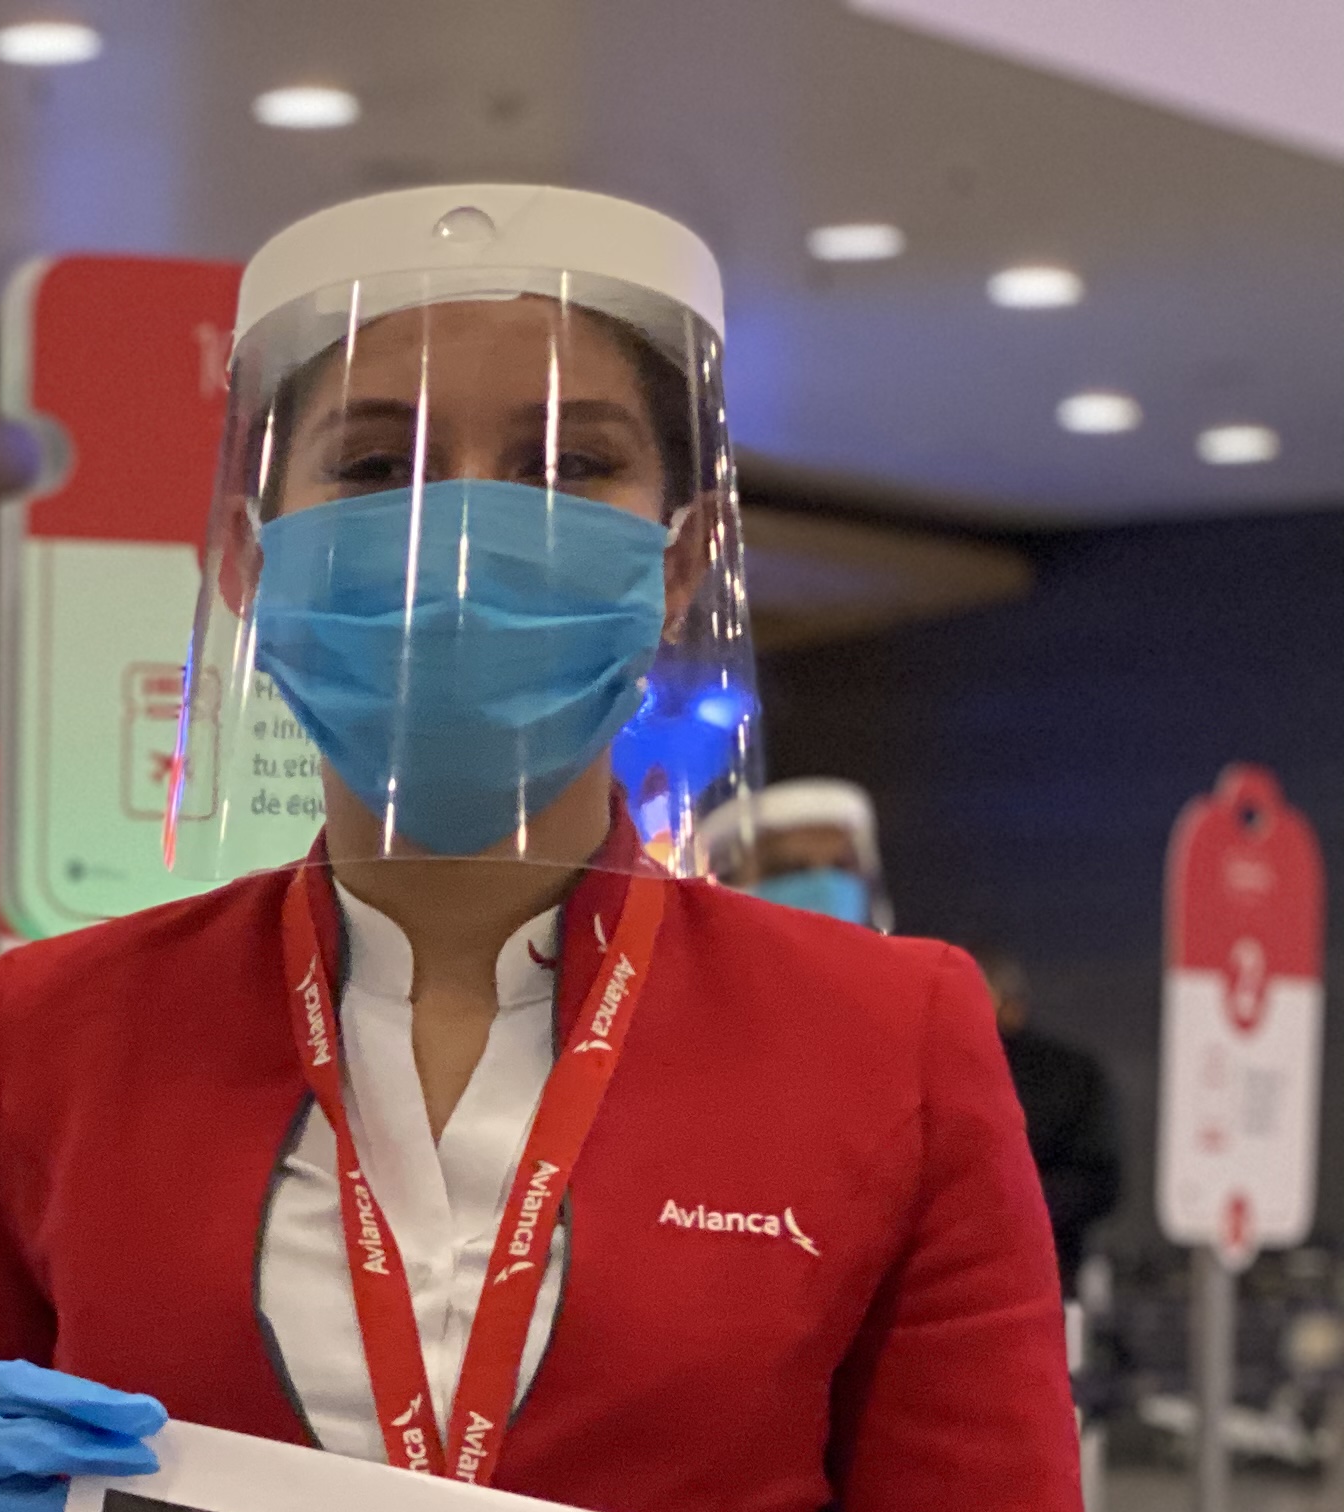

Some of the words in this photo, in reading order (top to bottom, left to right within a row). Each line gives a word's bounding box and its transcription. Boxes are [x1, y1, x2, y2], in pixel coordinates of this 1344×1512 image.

[590, 952, 637, 1038] Avianca
[355, 1184, 390, 1275] Avianca
[509, 1160, 561, 1256] Avianca
[659, 1199, 781, 1237] Avianca
